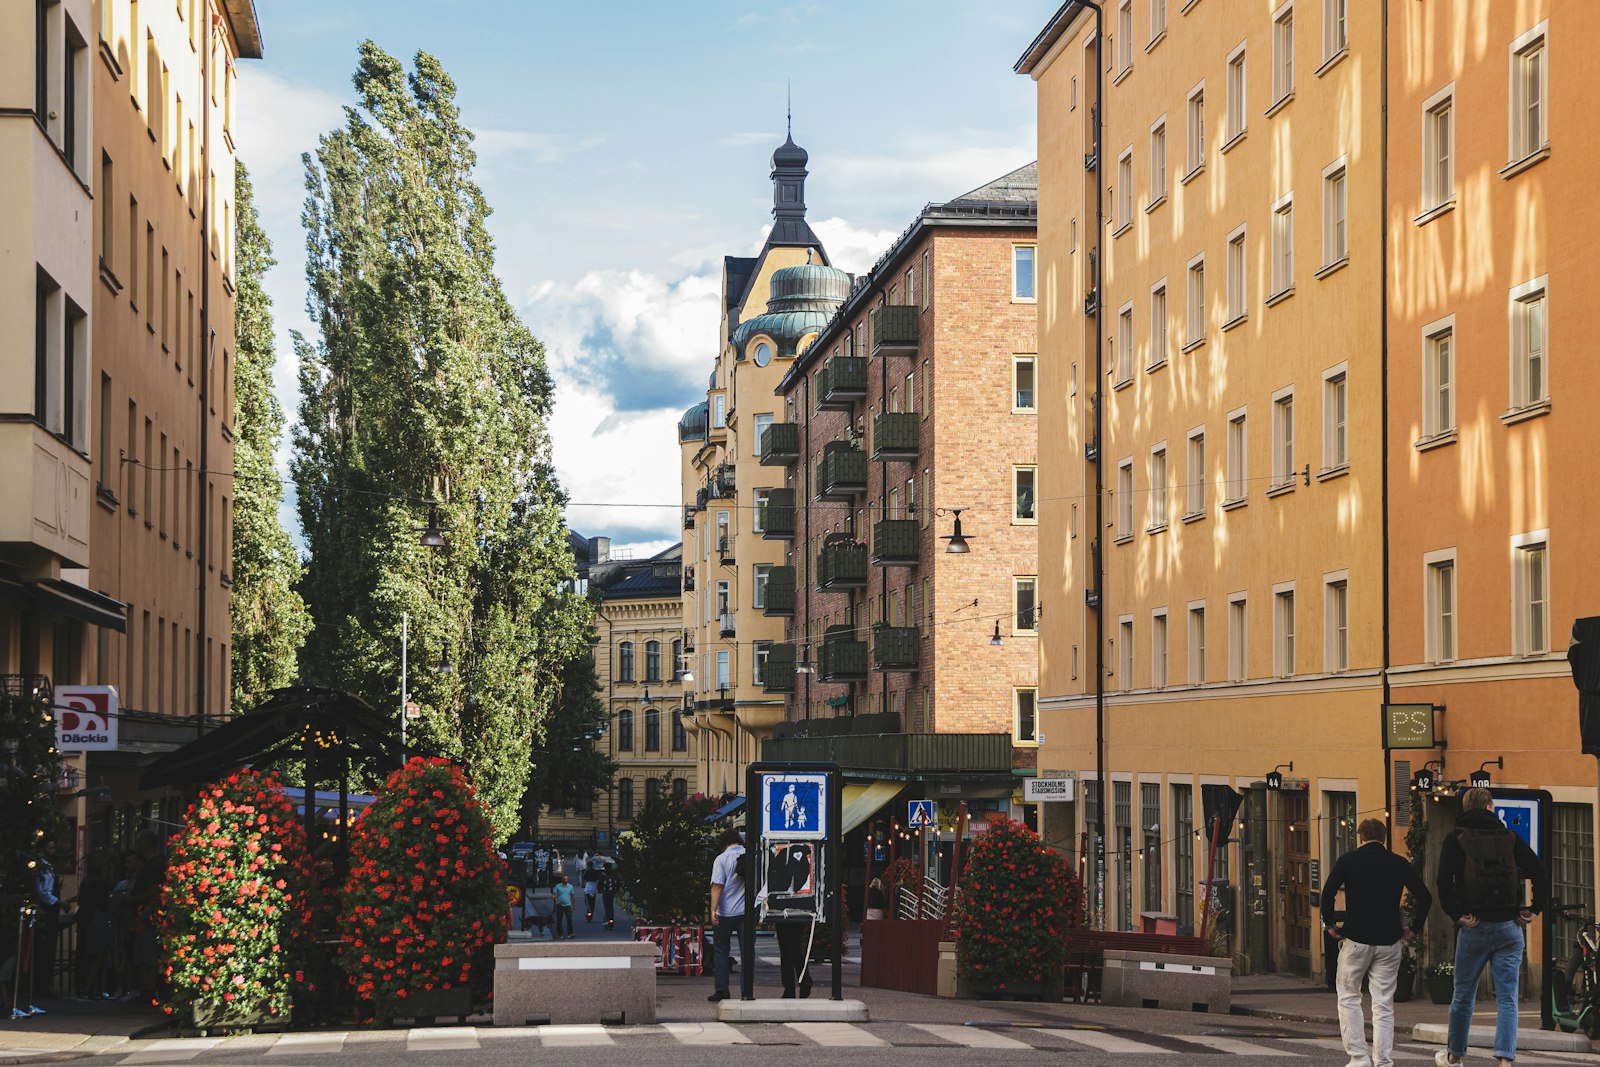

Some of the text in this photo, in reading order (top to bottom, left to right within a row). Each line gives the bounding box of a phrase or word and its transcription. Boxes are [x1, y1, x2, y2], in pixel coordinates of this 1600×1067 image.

[1392, 711, 1426, 733] PS
[62, 733, 108, 743] Däckia
[1268, 778, 1279, 788] 44
[1418, 777, 1430, 788] 42
